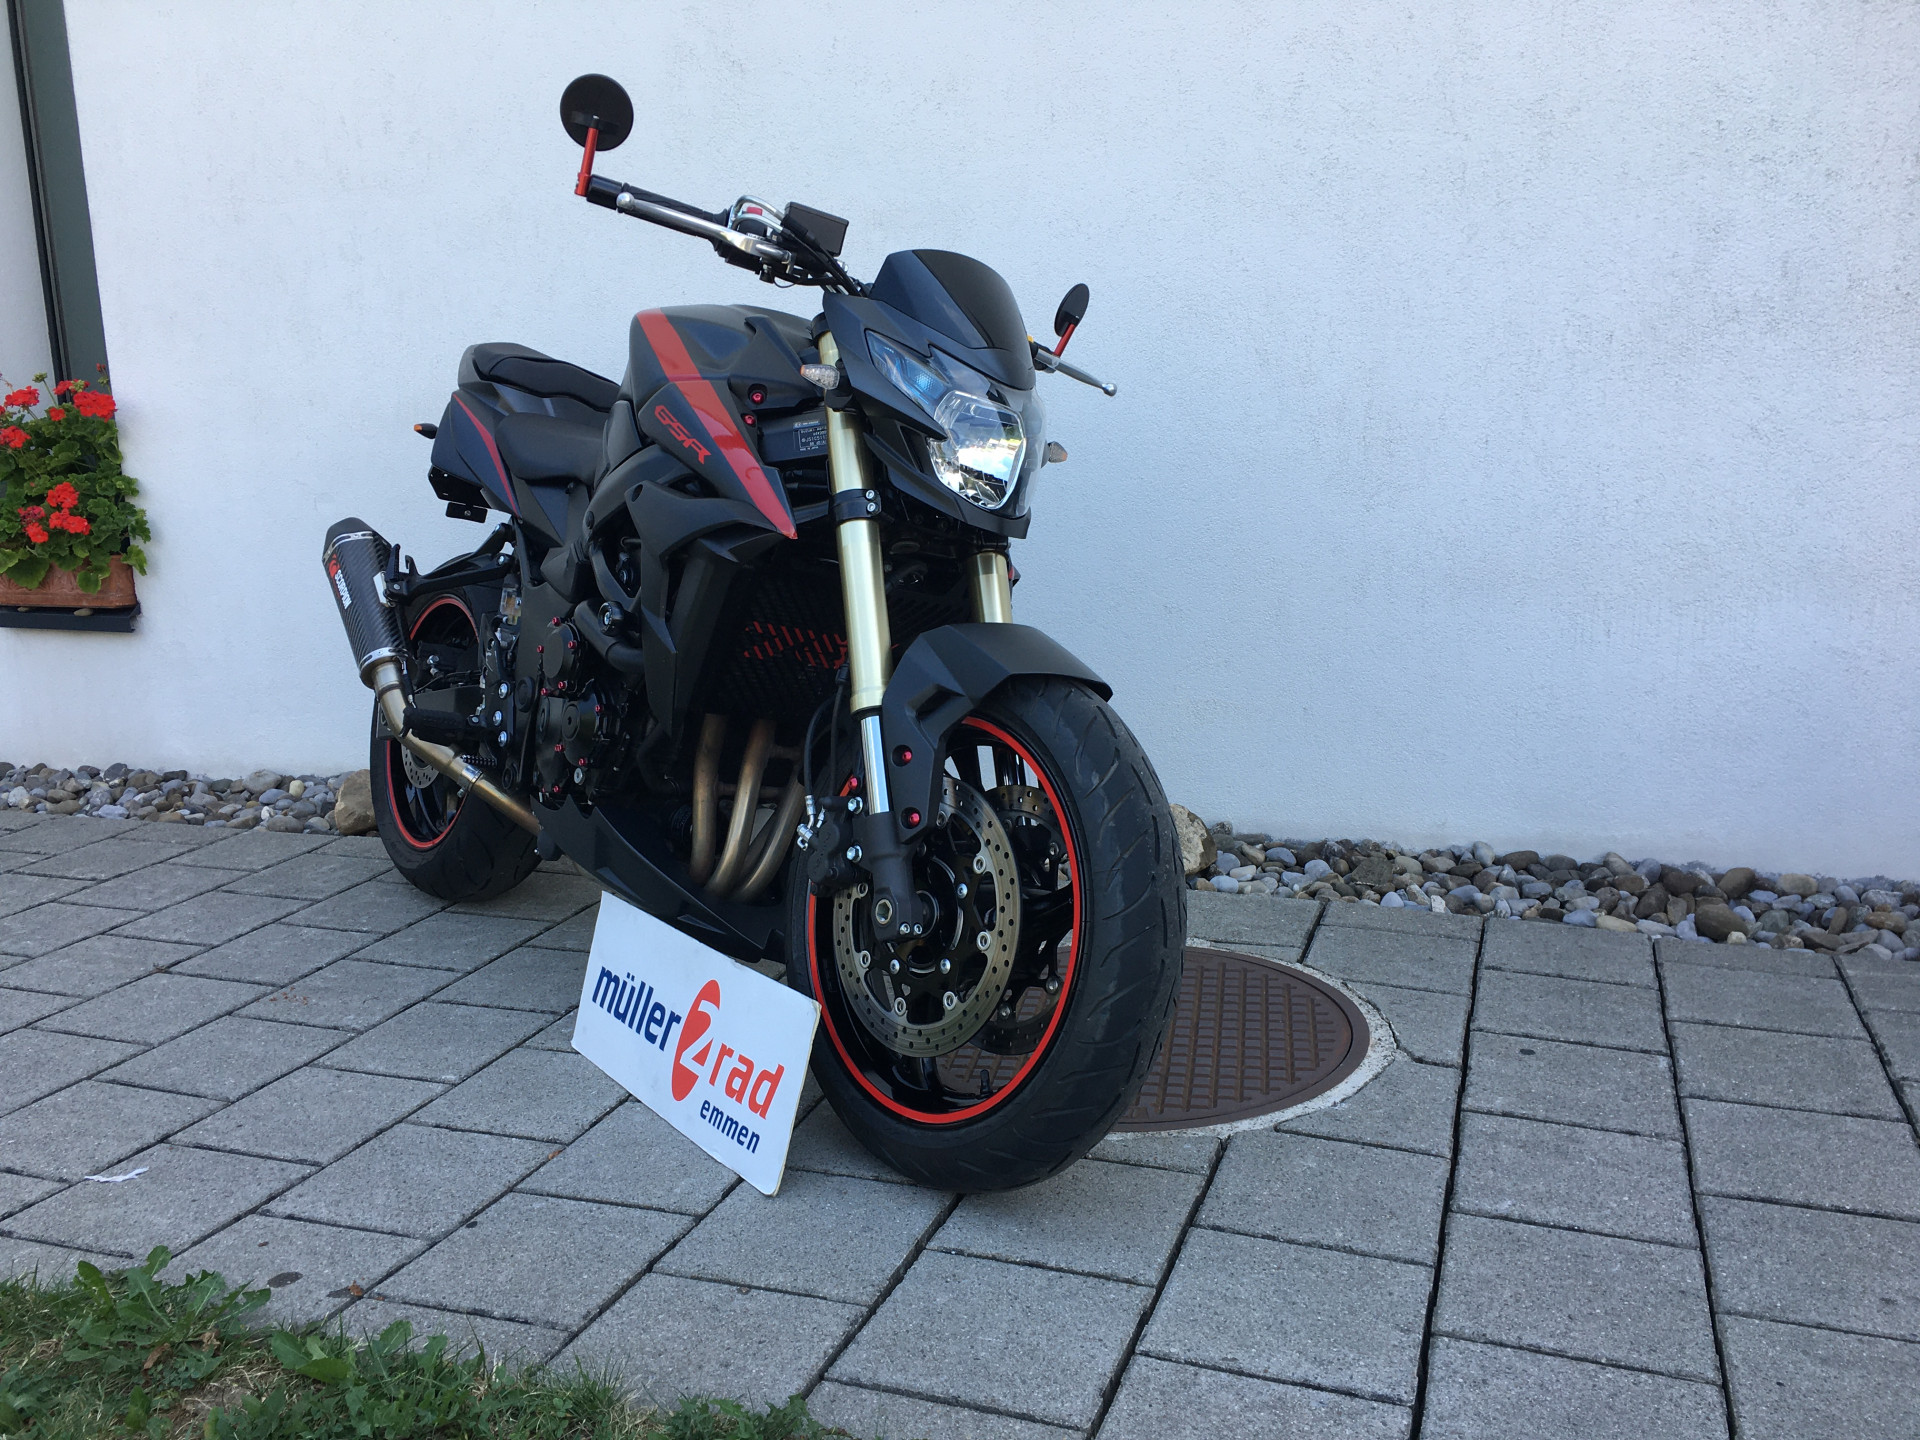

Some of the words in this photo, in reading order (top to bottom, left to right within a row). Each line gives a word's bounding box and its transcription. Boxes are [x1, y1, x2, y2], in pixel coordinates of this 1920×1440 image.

[654, 404, 712, 464] GSR
[592, 966, 682, 1052] müller
[700, 1100, 761, 1154] emmen
